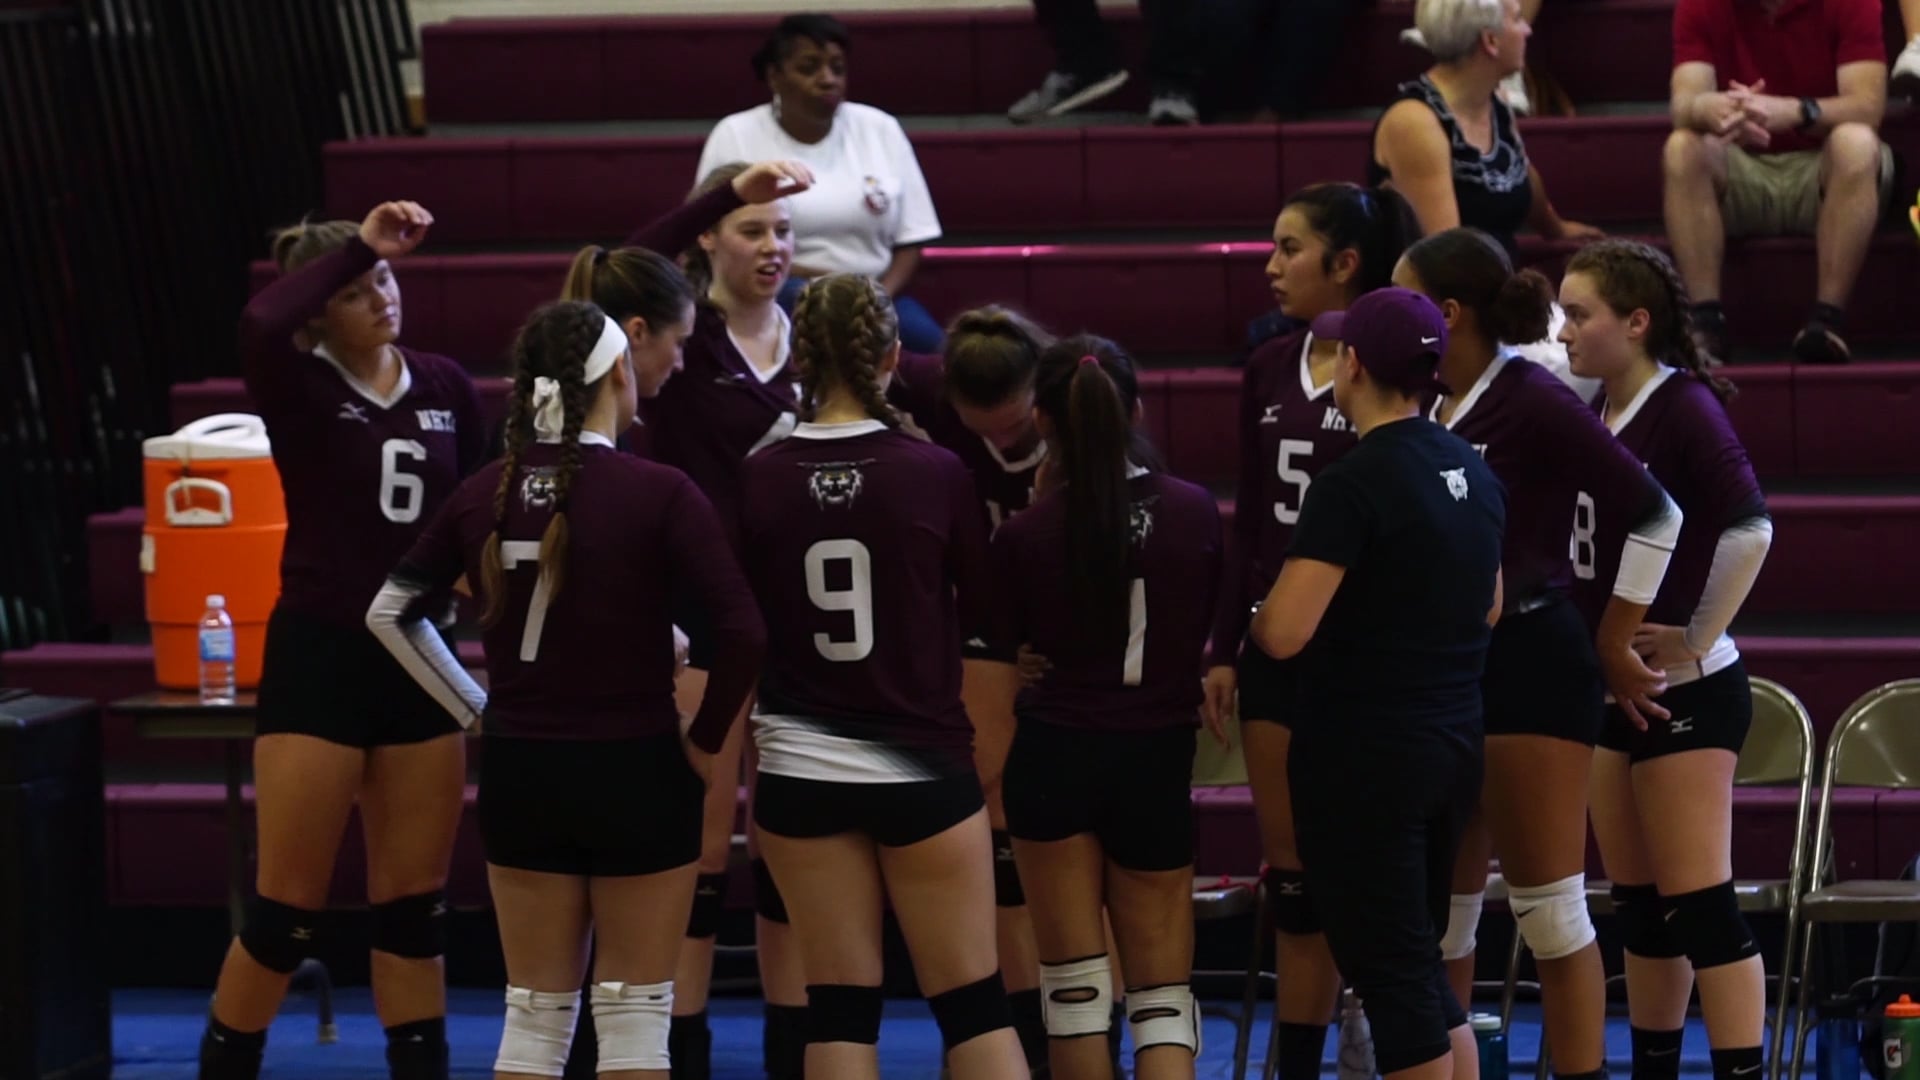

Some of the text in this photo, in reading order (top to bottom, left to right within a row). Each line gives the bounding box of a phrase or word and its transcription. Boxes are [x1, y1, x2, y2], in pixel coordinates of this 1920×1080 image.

[379, 438, 428, 524] 6
[1273, 438, 1314, 526] 5
[501, 540, 556, 662] 7
[803, 537, 875, 663] 9
[1122, 577, 1148, 687] 1
